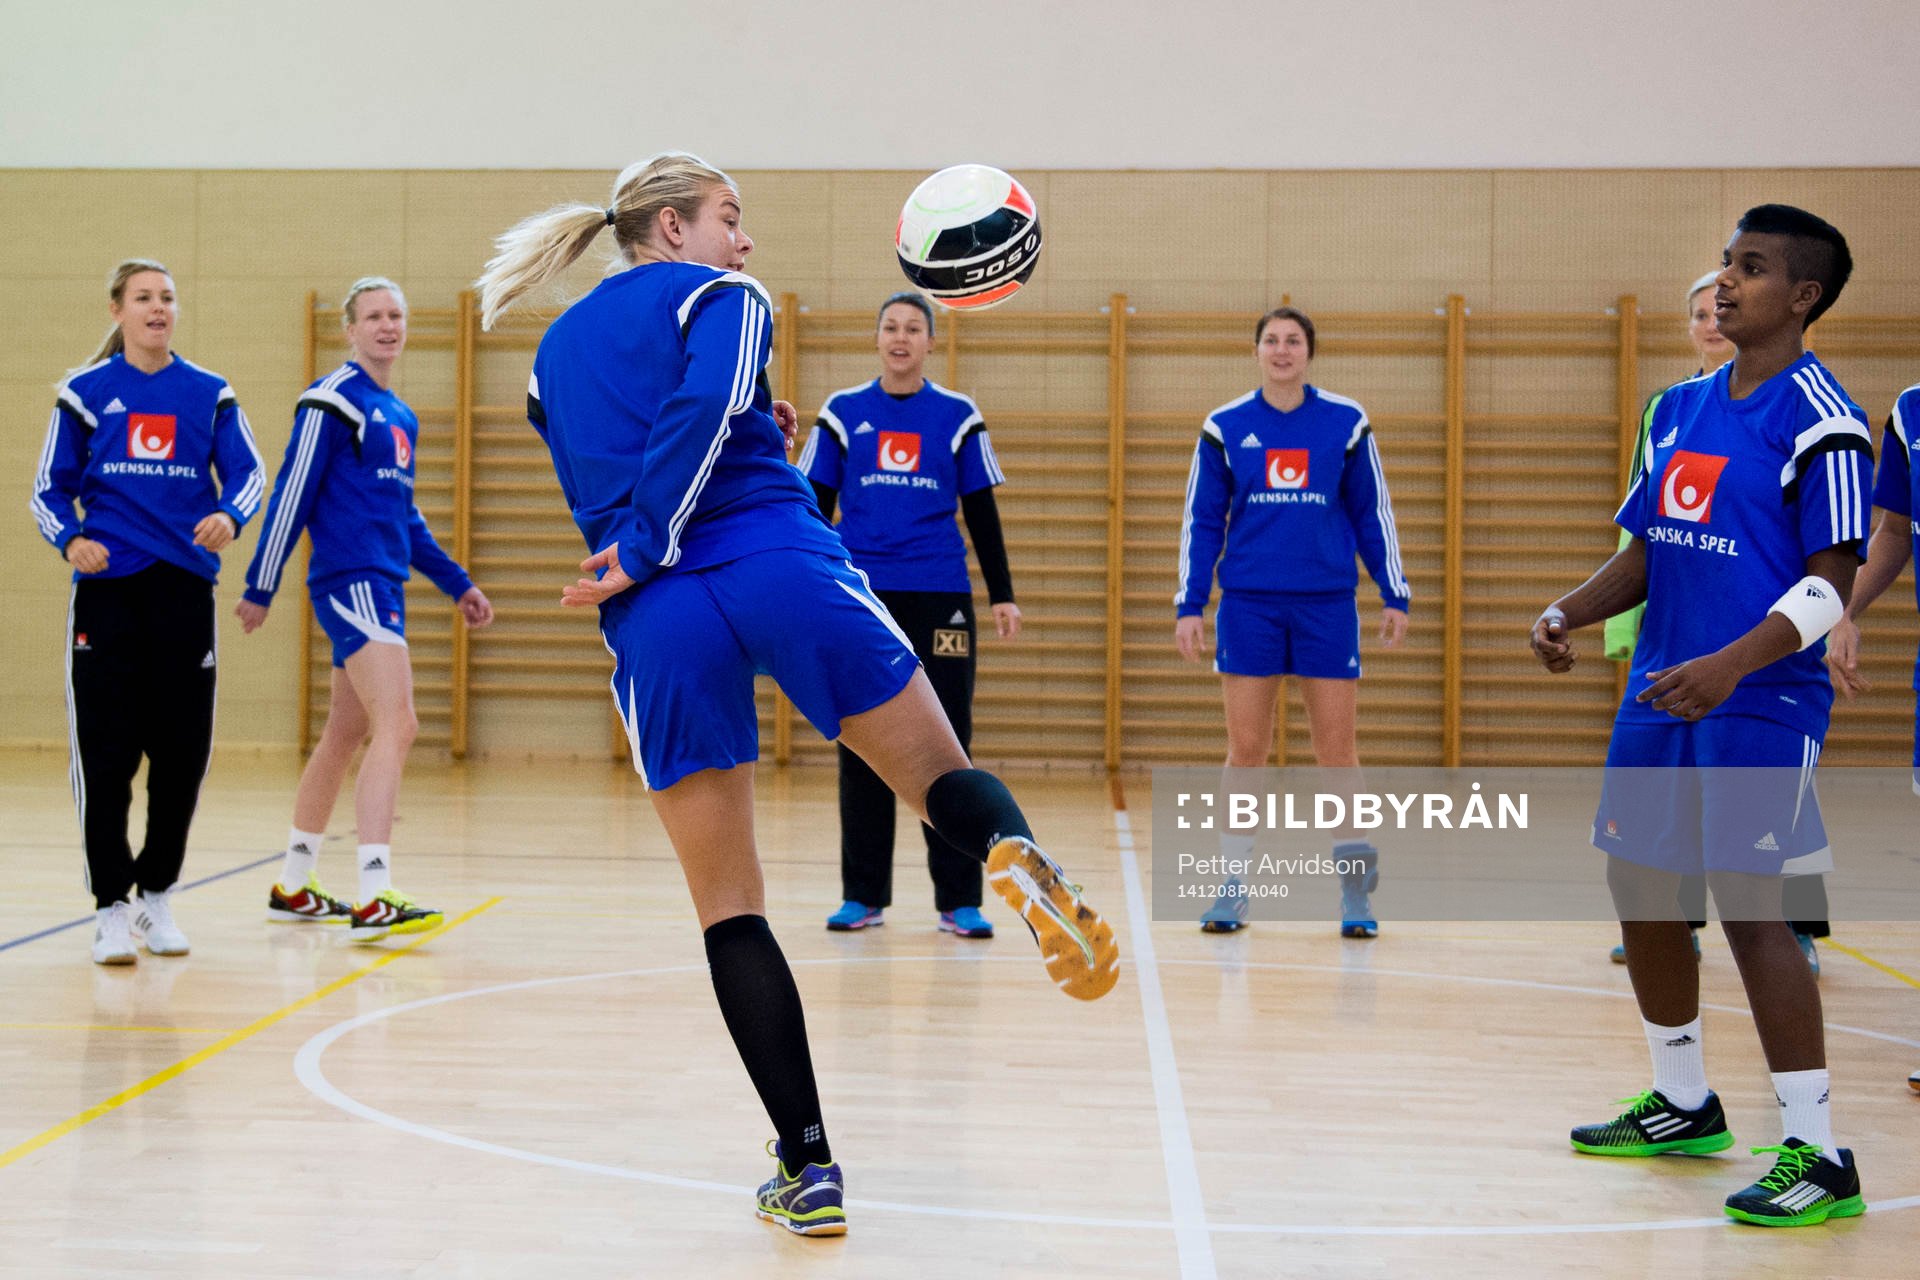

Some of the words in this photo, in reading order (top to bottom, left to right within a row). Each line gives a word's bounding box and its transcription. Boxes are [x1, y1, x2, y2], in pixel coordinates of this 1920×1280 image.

[102, 462, 164, 476] SVENSKA
[167, 465, 198, 479] SPEL
[860, 473, 909, 487] SENSKA
[911, 477, 939, 490] SPEL
[1247, 492, 1299, 504] VENSKA
[1301, 492, 1327, 506] SPEL
[1698, 533, 1739, 557] SPEL
[937, 633, 968, 653] XL
